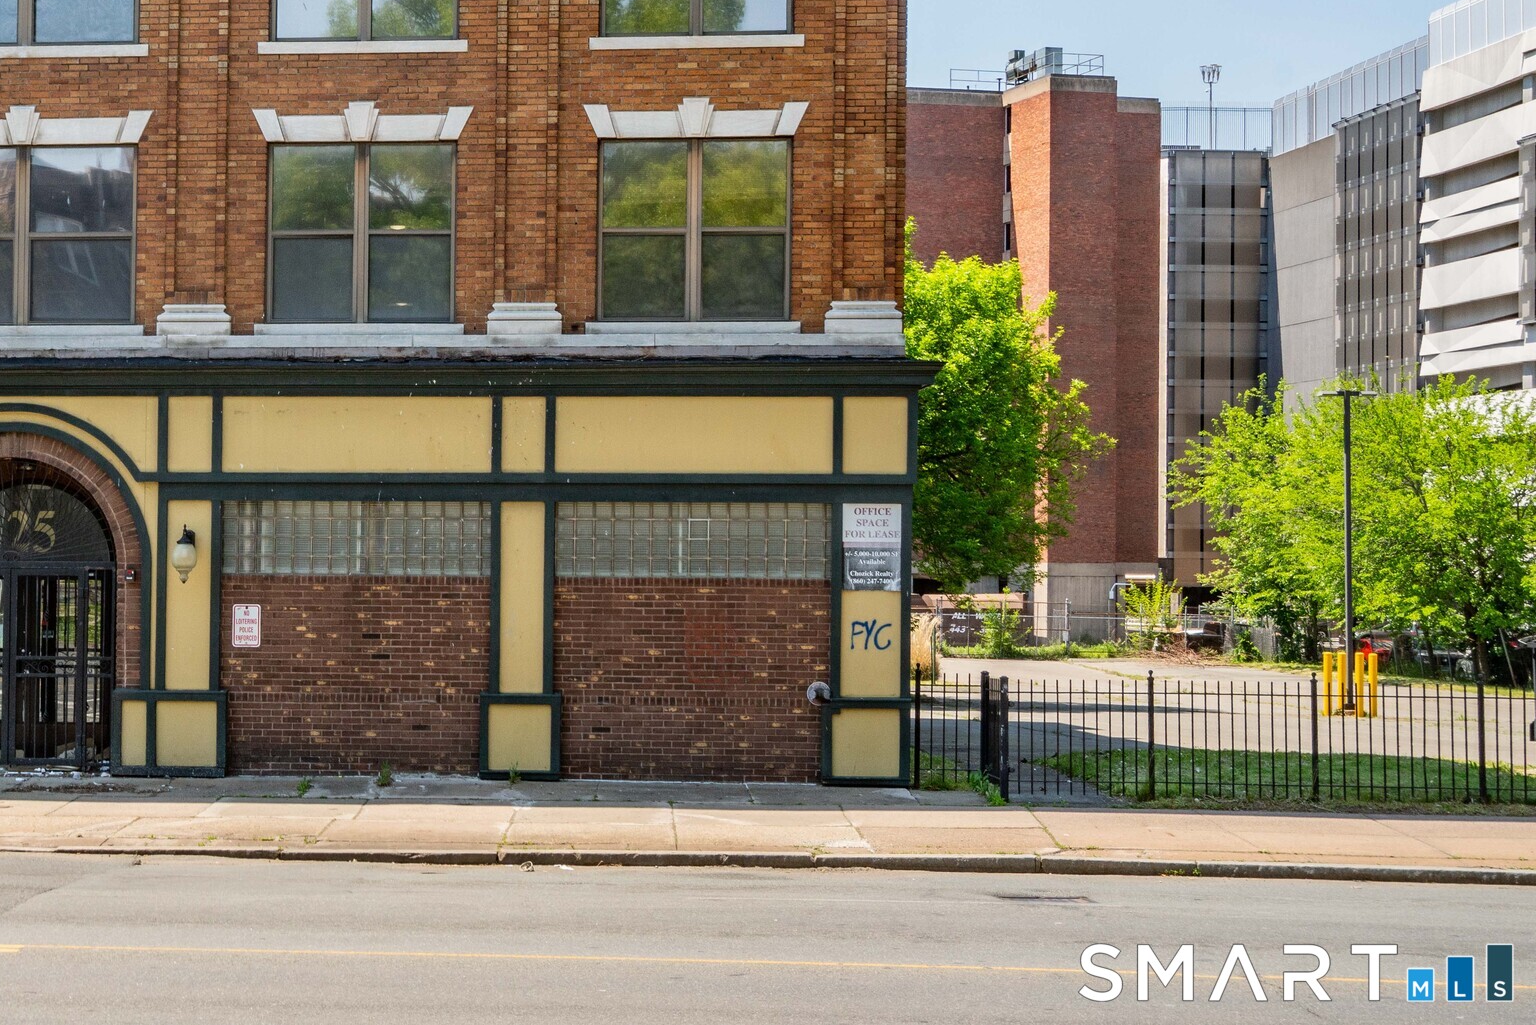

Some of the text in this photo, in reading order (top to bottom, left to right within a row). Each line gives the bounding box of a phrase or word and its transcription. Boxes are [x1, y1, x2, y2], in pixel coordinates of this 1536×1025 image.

[854, 507, 892, 516] OFFICE
[856, 518, 890, 527] SPACE
[7, 510, 56, 554] 25
[844, 530, 901, 539] FOR LEASE
[874, 570, 894, 578] Realty
[951, 612, 967, 620] ALL
[850, 619, 892, 651] FYC
